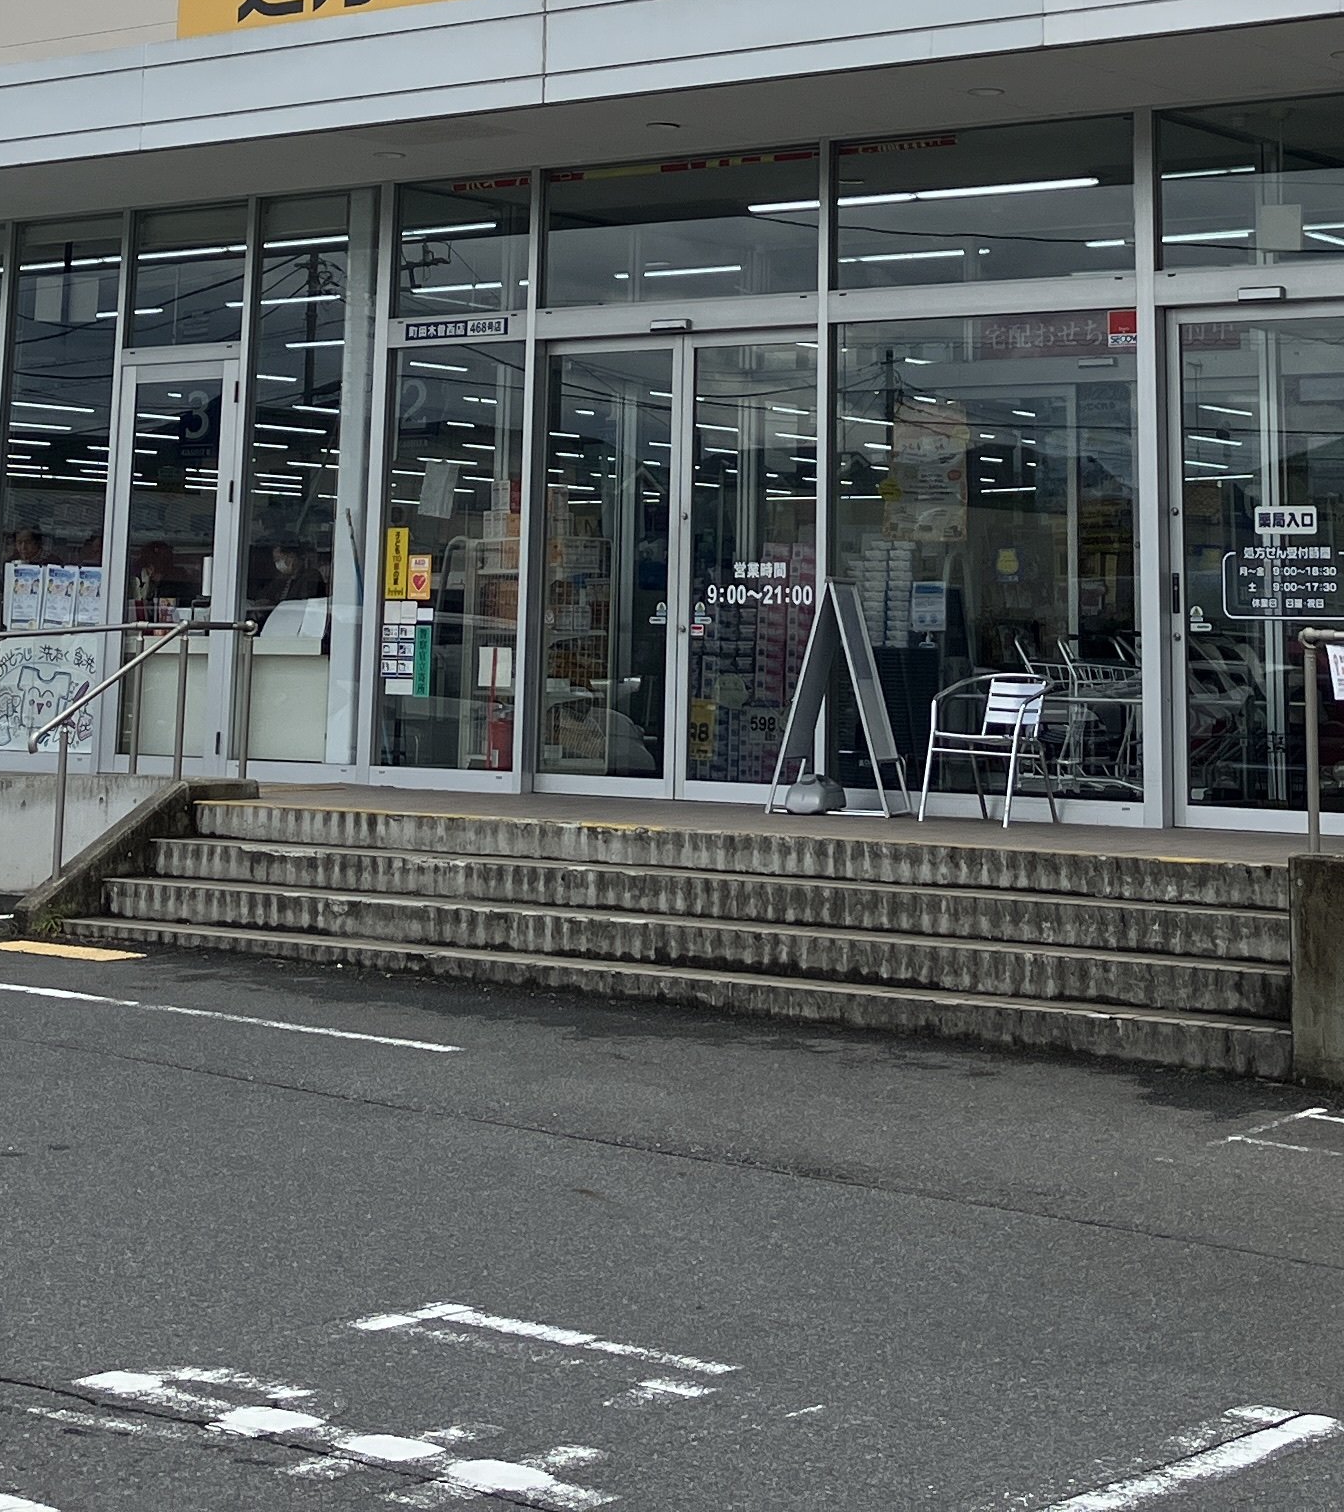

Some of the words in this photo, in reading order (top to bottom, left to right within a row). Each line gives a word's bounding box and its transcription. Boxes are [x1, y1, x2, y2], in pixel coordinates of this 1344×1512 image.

[185, 390, 209, 439] 3
[1258, 512, 1314, 528] 薬局入口
[1243, 546, 1331, 560] 処方せん受付時間
[733, 561, 787, 579] 営業時間
[707, 584, 813, 605] 9:00～21:00
[1247, 582, 1257, 592] 土
[750, 716, 776, 732] 598
